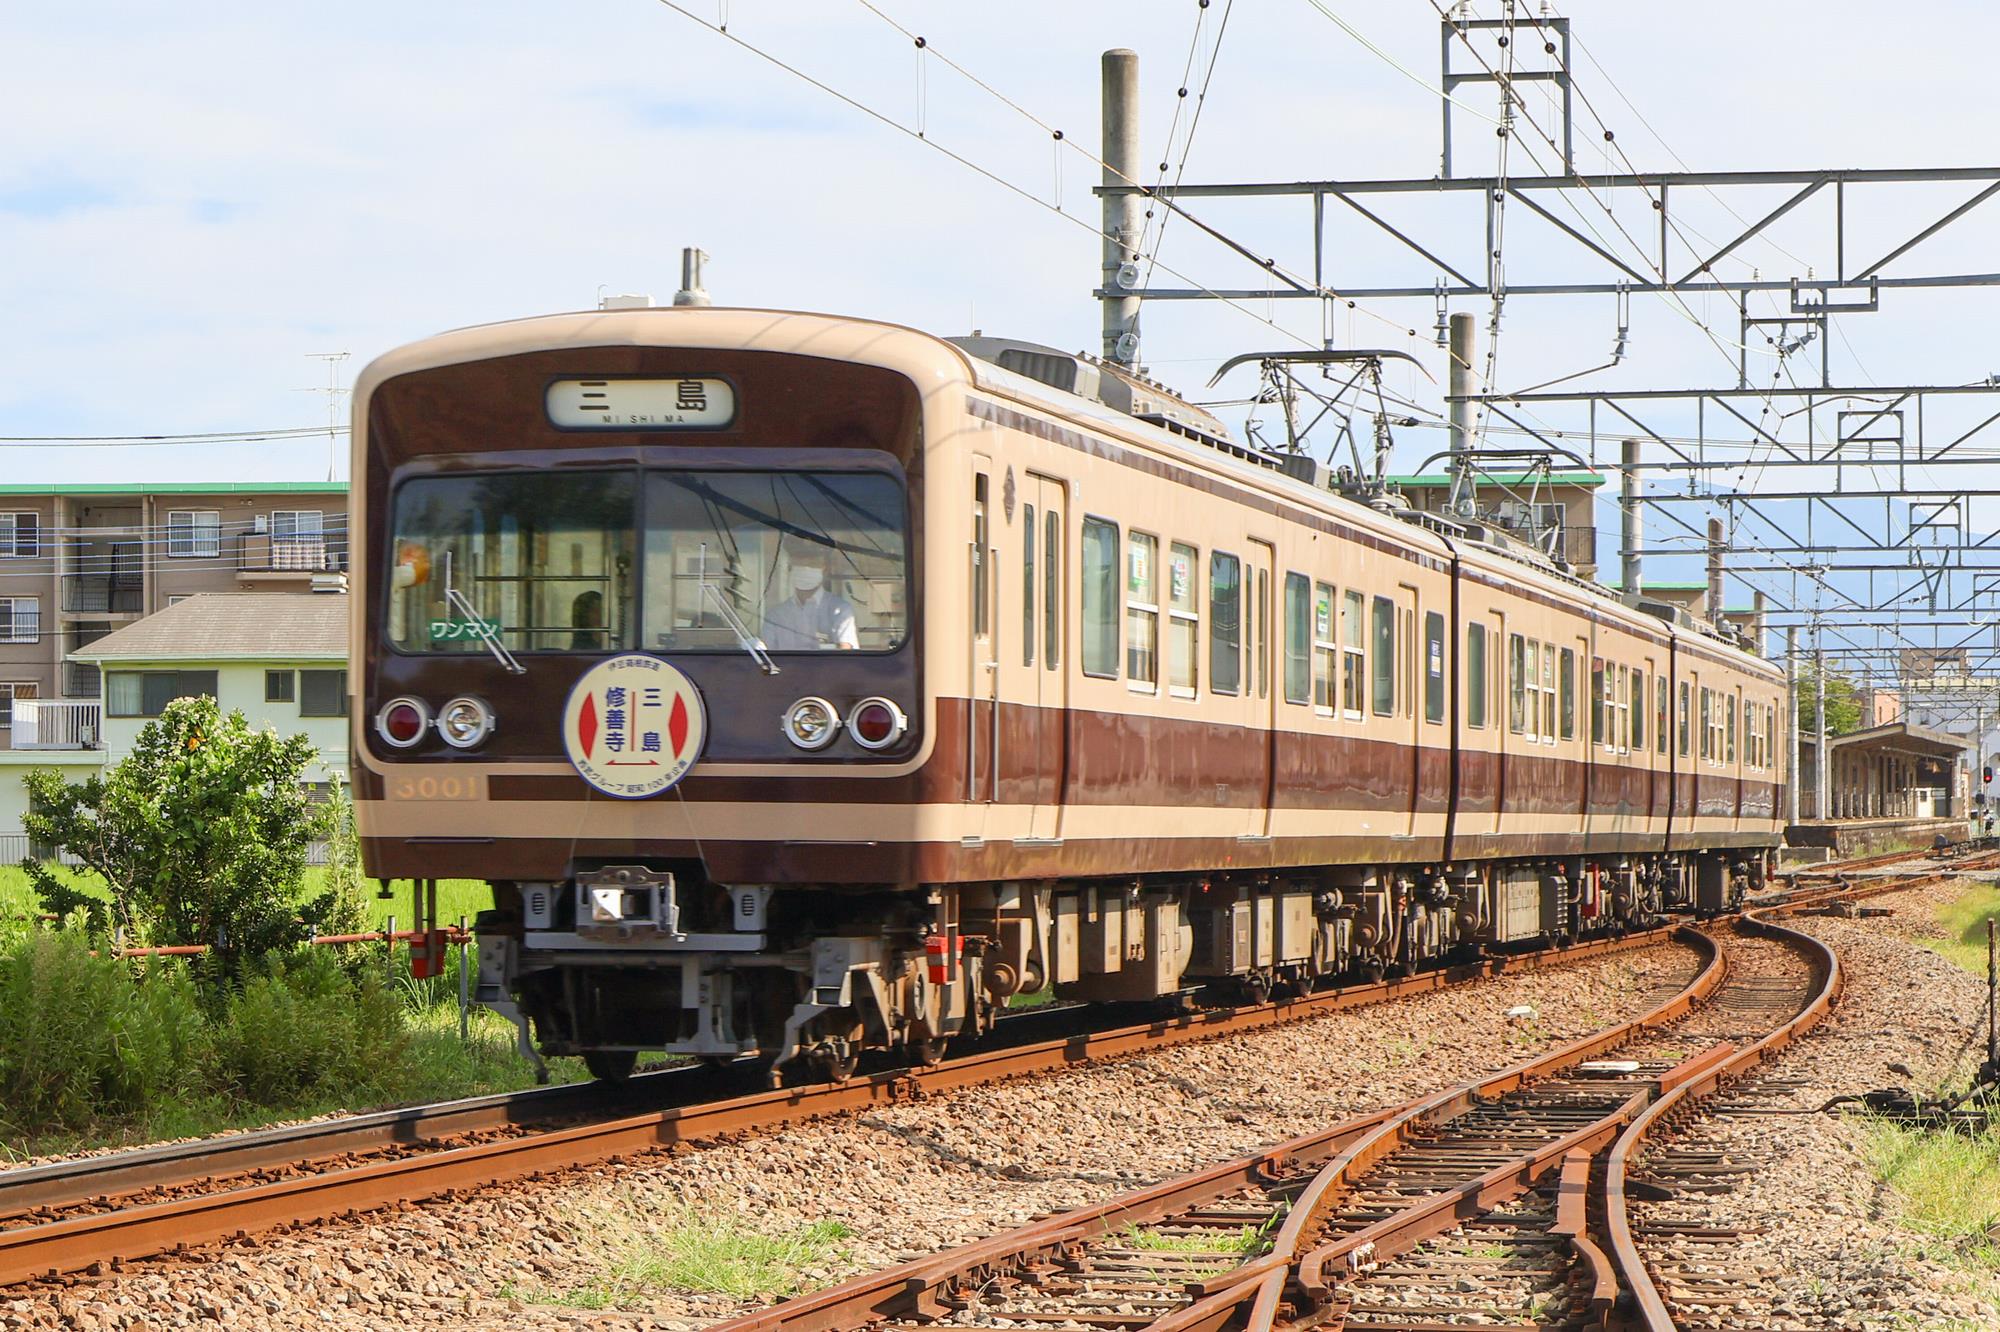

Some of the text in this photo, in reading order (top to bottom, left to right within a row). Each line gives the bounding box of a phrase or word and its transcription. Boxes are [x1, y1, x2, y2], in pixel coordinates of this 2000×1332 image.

[579, 381, 706, 412] 三島
[602, 415, 685, 423] MISHIMA
[431, 622, 498, 638] ワンマン
[605, 687, 626, 752] 修善寺
[641, 688, 662, 752] 三島
[395, 777, 477, 798] 3001
